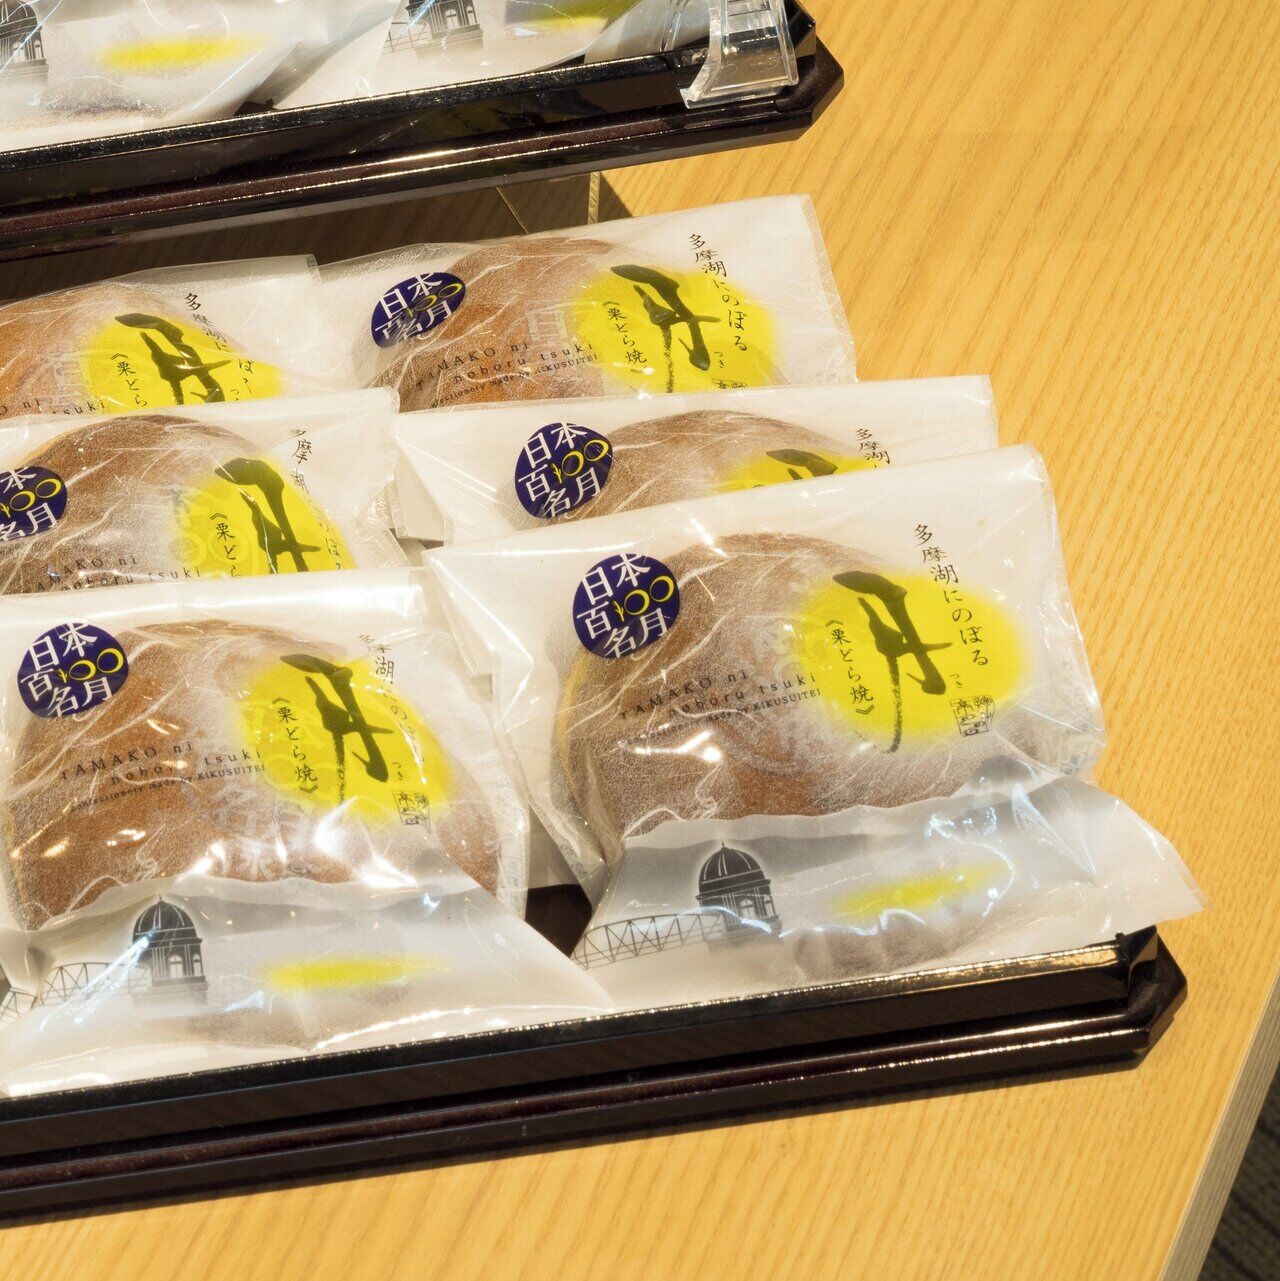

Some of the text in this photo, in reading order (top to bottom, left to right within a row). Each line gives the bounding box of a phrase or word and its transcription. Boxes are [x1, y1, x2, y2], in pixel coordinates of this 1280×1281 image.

[378, 273, 442, 319] 日本
[689, 233, 748, 351] 多摩湖にのぼる
[610, 264, 722, 393] 月
[524, 422, 587, 468] 日本
[543, 467, 600, 517] 名月
[581, 553, 651, 605] 日本
[914, 524, 988, 666] 多摩湖にのぼる
[28, 623, 97, 670] 日本
[604, 608, 669, 658] 名月
[832, 571, 953, 753] 月
[47, 677, 114, 717] 名月
[620, 677, 712, 720] TAMAKO
[60, 747, 157, 782] TAMAKO
